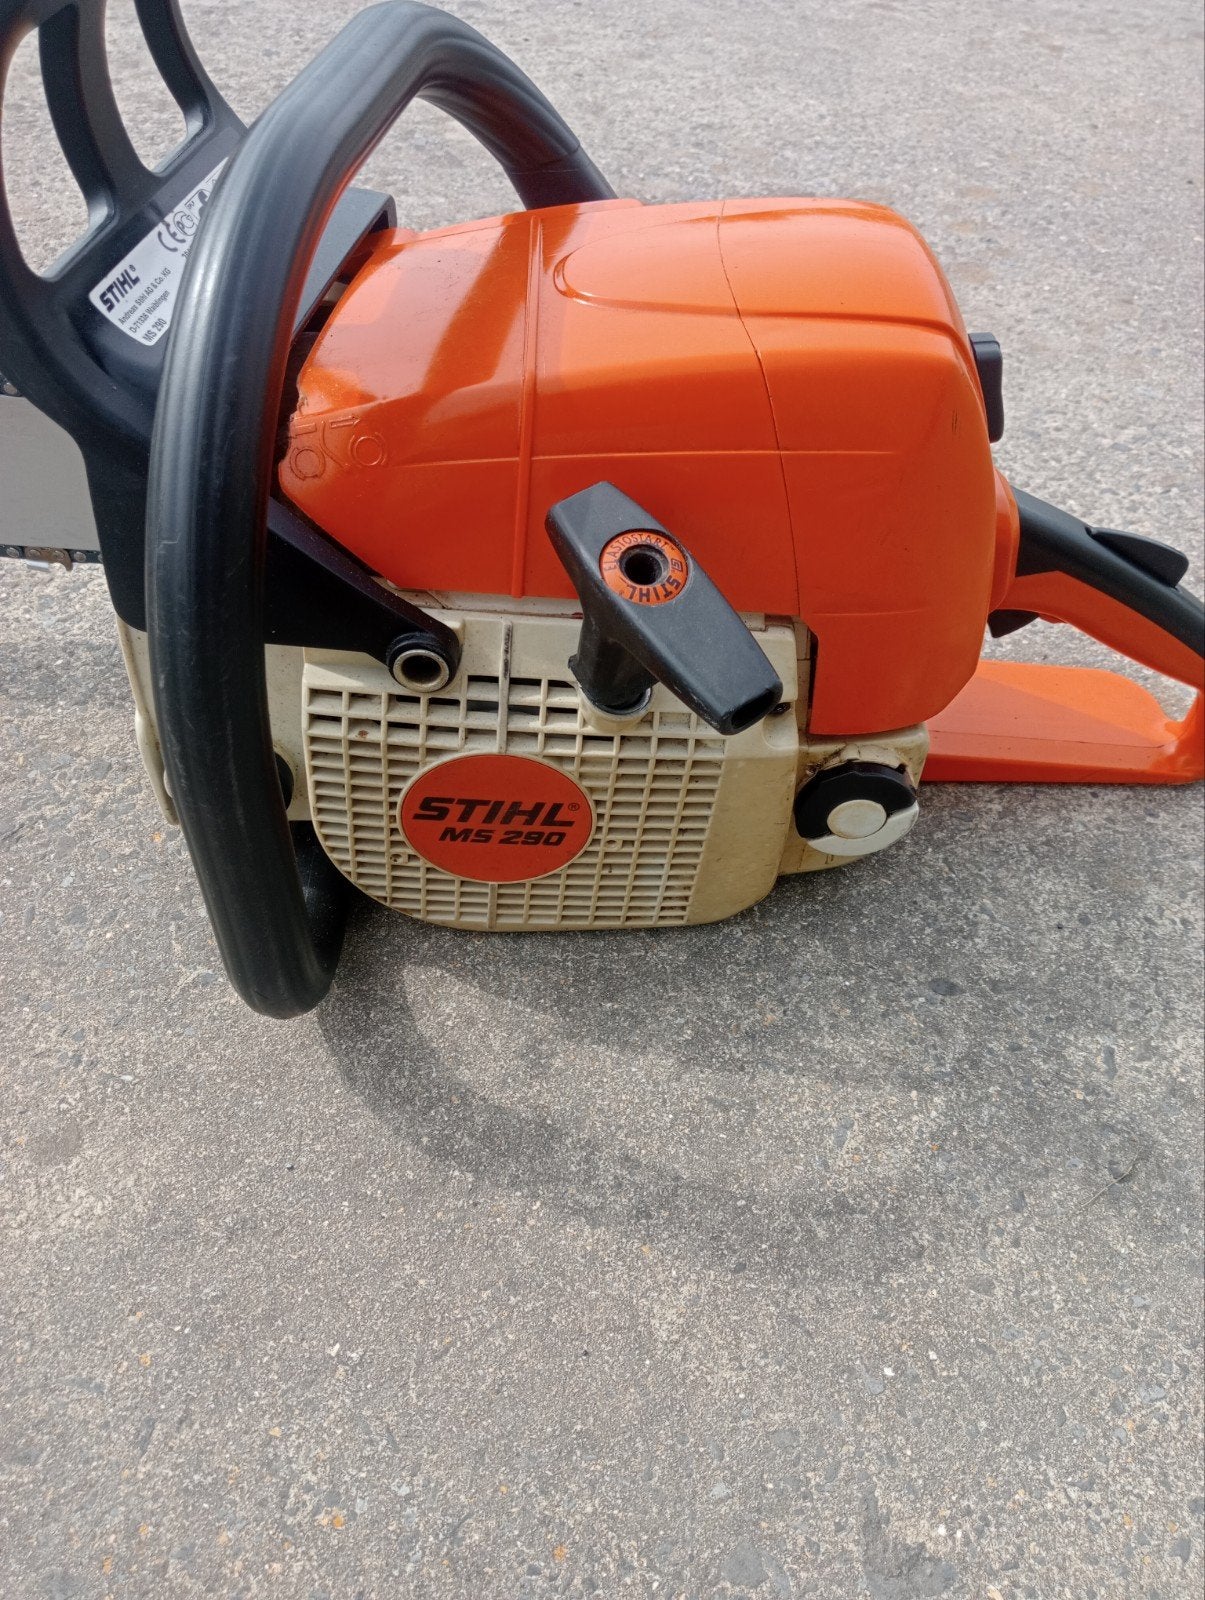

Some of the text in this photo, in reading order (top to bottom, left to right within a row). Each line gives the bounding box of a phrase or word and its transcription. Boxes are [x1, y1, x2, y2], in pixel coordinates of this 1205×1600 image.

[99, 269, 140, 313] STIHL
[118, 304, 138, 325] Andreas
[142, 318, 167, 343] MS 290
[438, 827, 567, 847] MS 290
